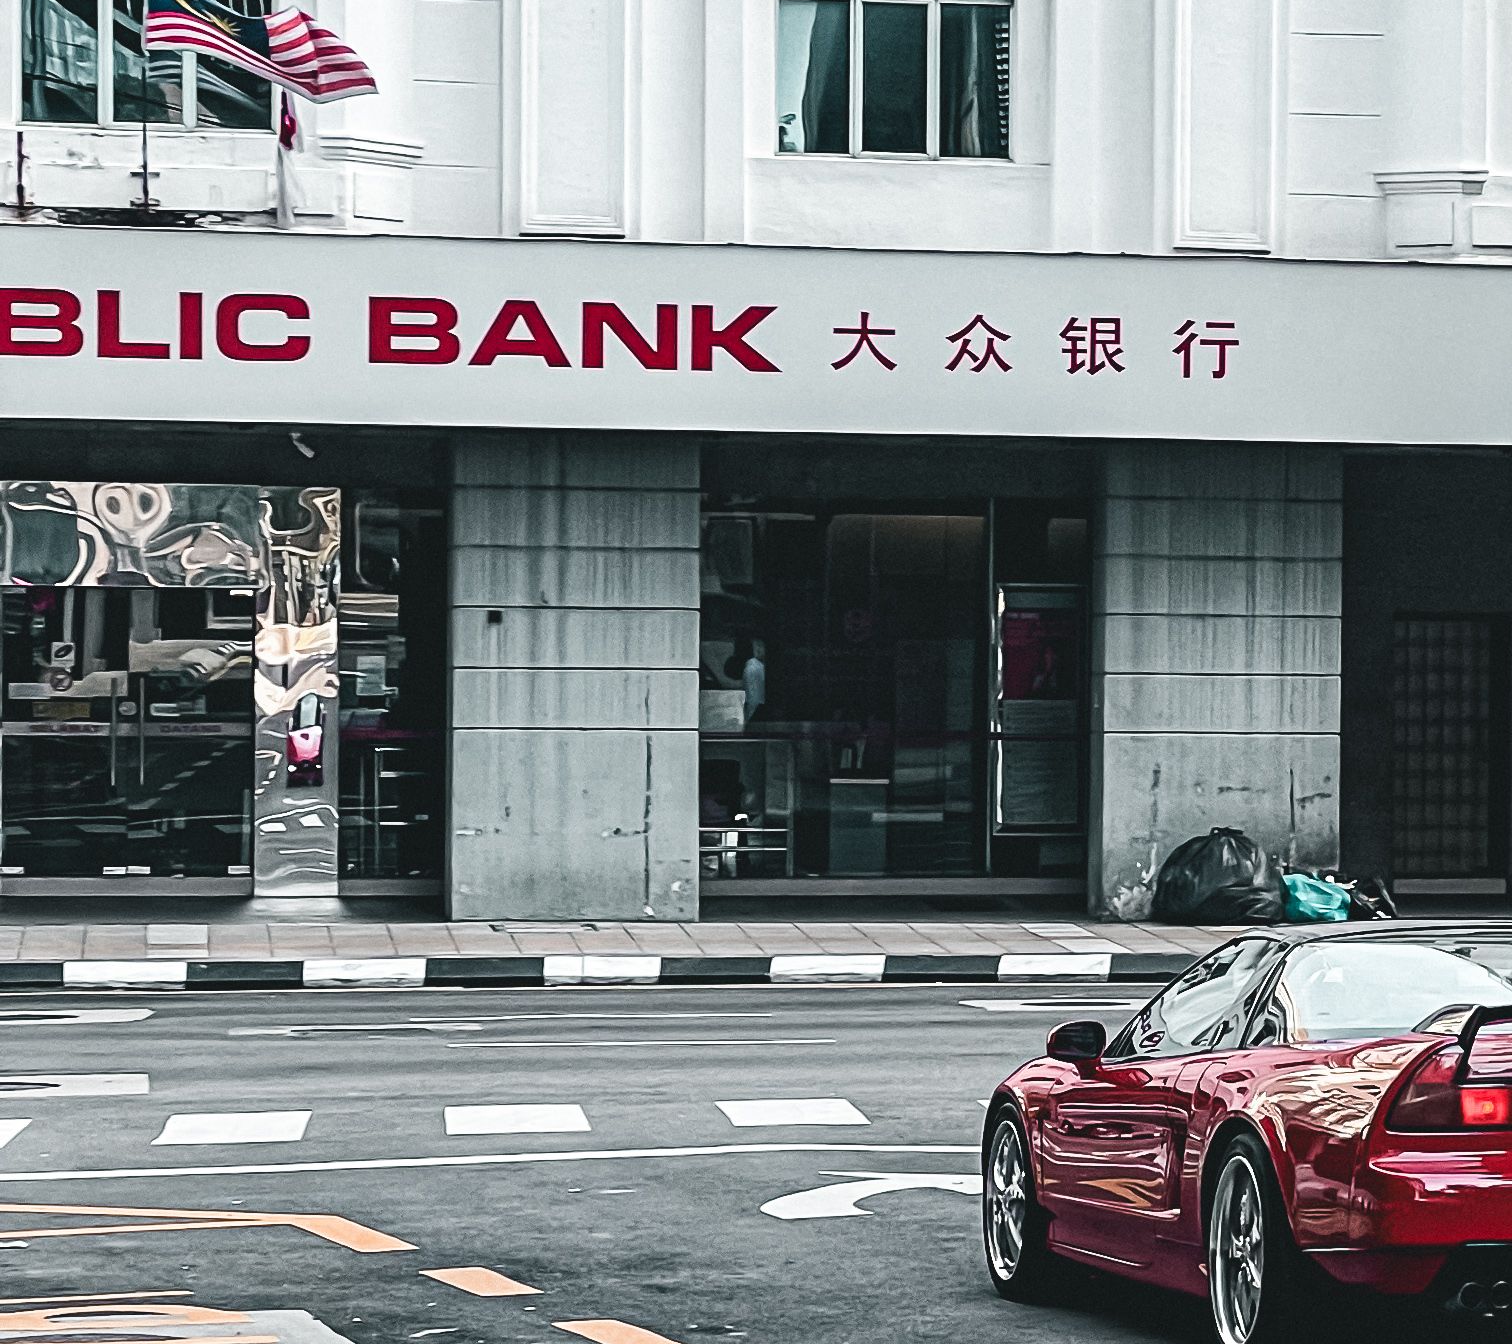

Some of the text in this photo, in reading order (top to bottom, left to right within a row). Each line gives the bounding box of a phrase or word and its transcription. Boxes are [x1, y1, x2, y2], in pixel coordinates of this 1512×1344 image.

[0, 290, 784, 372] BLIC BANK
[831, 311, 1241, 379] 大众银行
